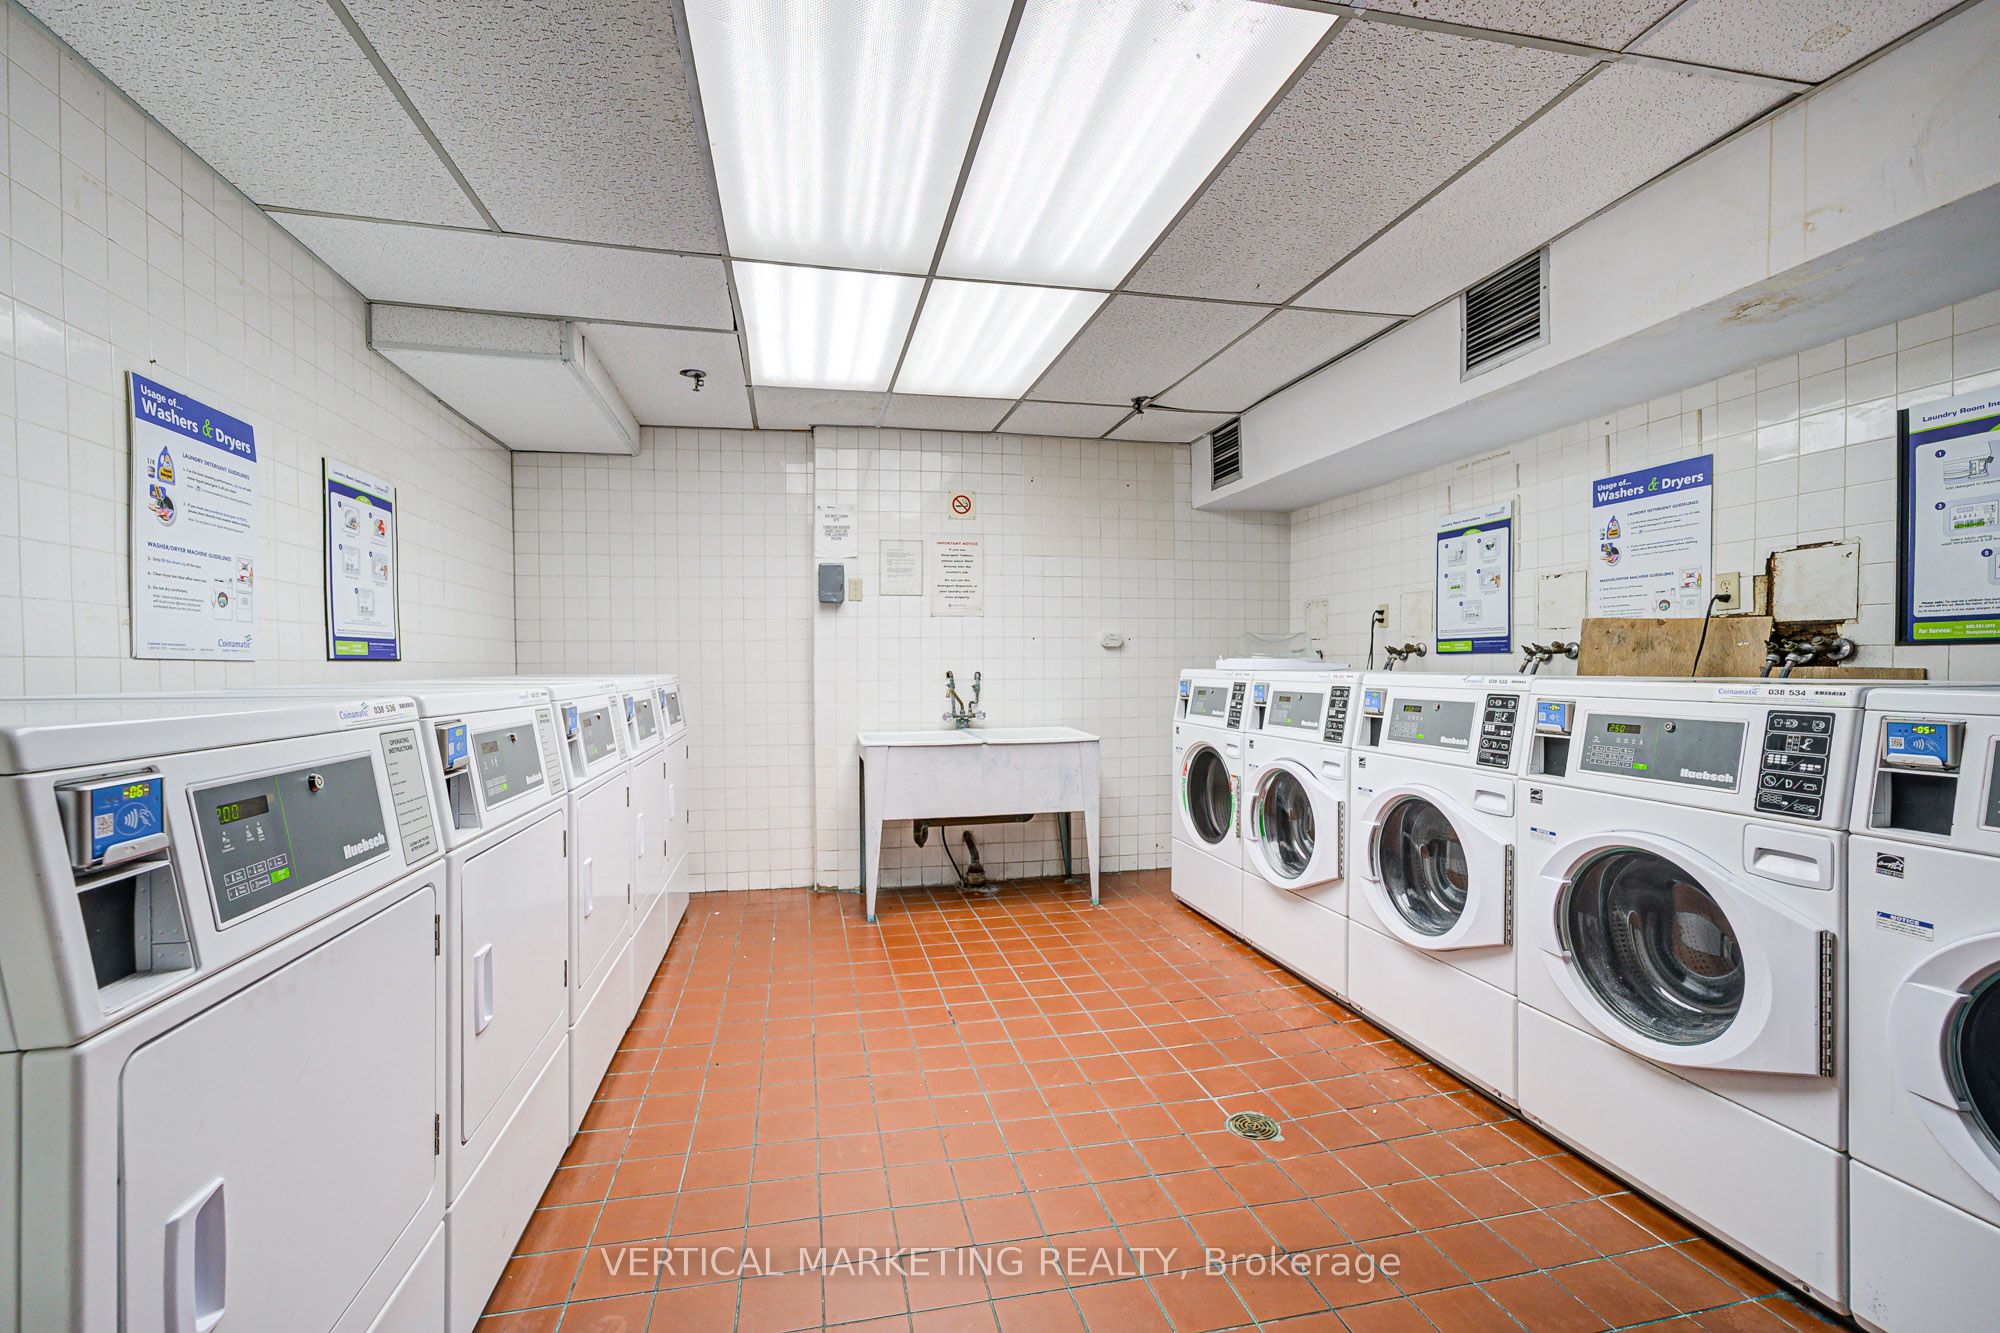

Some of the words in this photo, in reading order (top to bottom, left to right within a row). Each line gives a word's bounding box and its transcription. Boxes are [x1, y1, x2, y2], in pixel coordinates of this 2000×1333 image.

[140, 384, 166, 404] Usage
[1922, 411, 1957, 422] Laundry
[1960, 404, 1984, 414] Room
[142, 398, 198, 433] Washers
[202, 418, 214, 438] &
[216, 428, 250, 454] Dryers
[182, 453, 203, 464] LAUNDRY
[204, 460, 228, 472] DETERGENT
[228, 468, 250, 480] GUIDELINES
[1598, 483, 1616, 492] Usage
[1598, 485, 1644, 502] Washers
[1648, 476, 1660, 491] &
[1662, 473, 1704, 489] Dryers
[1672, 500, 1698, 508] GUIDELINES
[148, 542, 186, 552] WASHER/DRYER
[187, 548, 208, 557] MACHINE
[208, 552, 232, 562] GUIDELINES
[218, 638, 251, 649] Coinamatic
[1718, 687, 1758, 696] Coinamatic
[340, 710, 368, 720] Coinamatic
[374, 706, 384, 714] 038
[390, 737, 409, 746] OPERATING
[388, 744, 413, 754] INSTRUCTIONS
[1680, 768, 1734, 783] Huebsch
[344, 832, 386, 860] Huebsch
[1890, 914, 1920, 926] NOTICE
